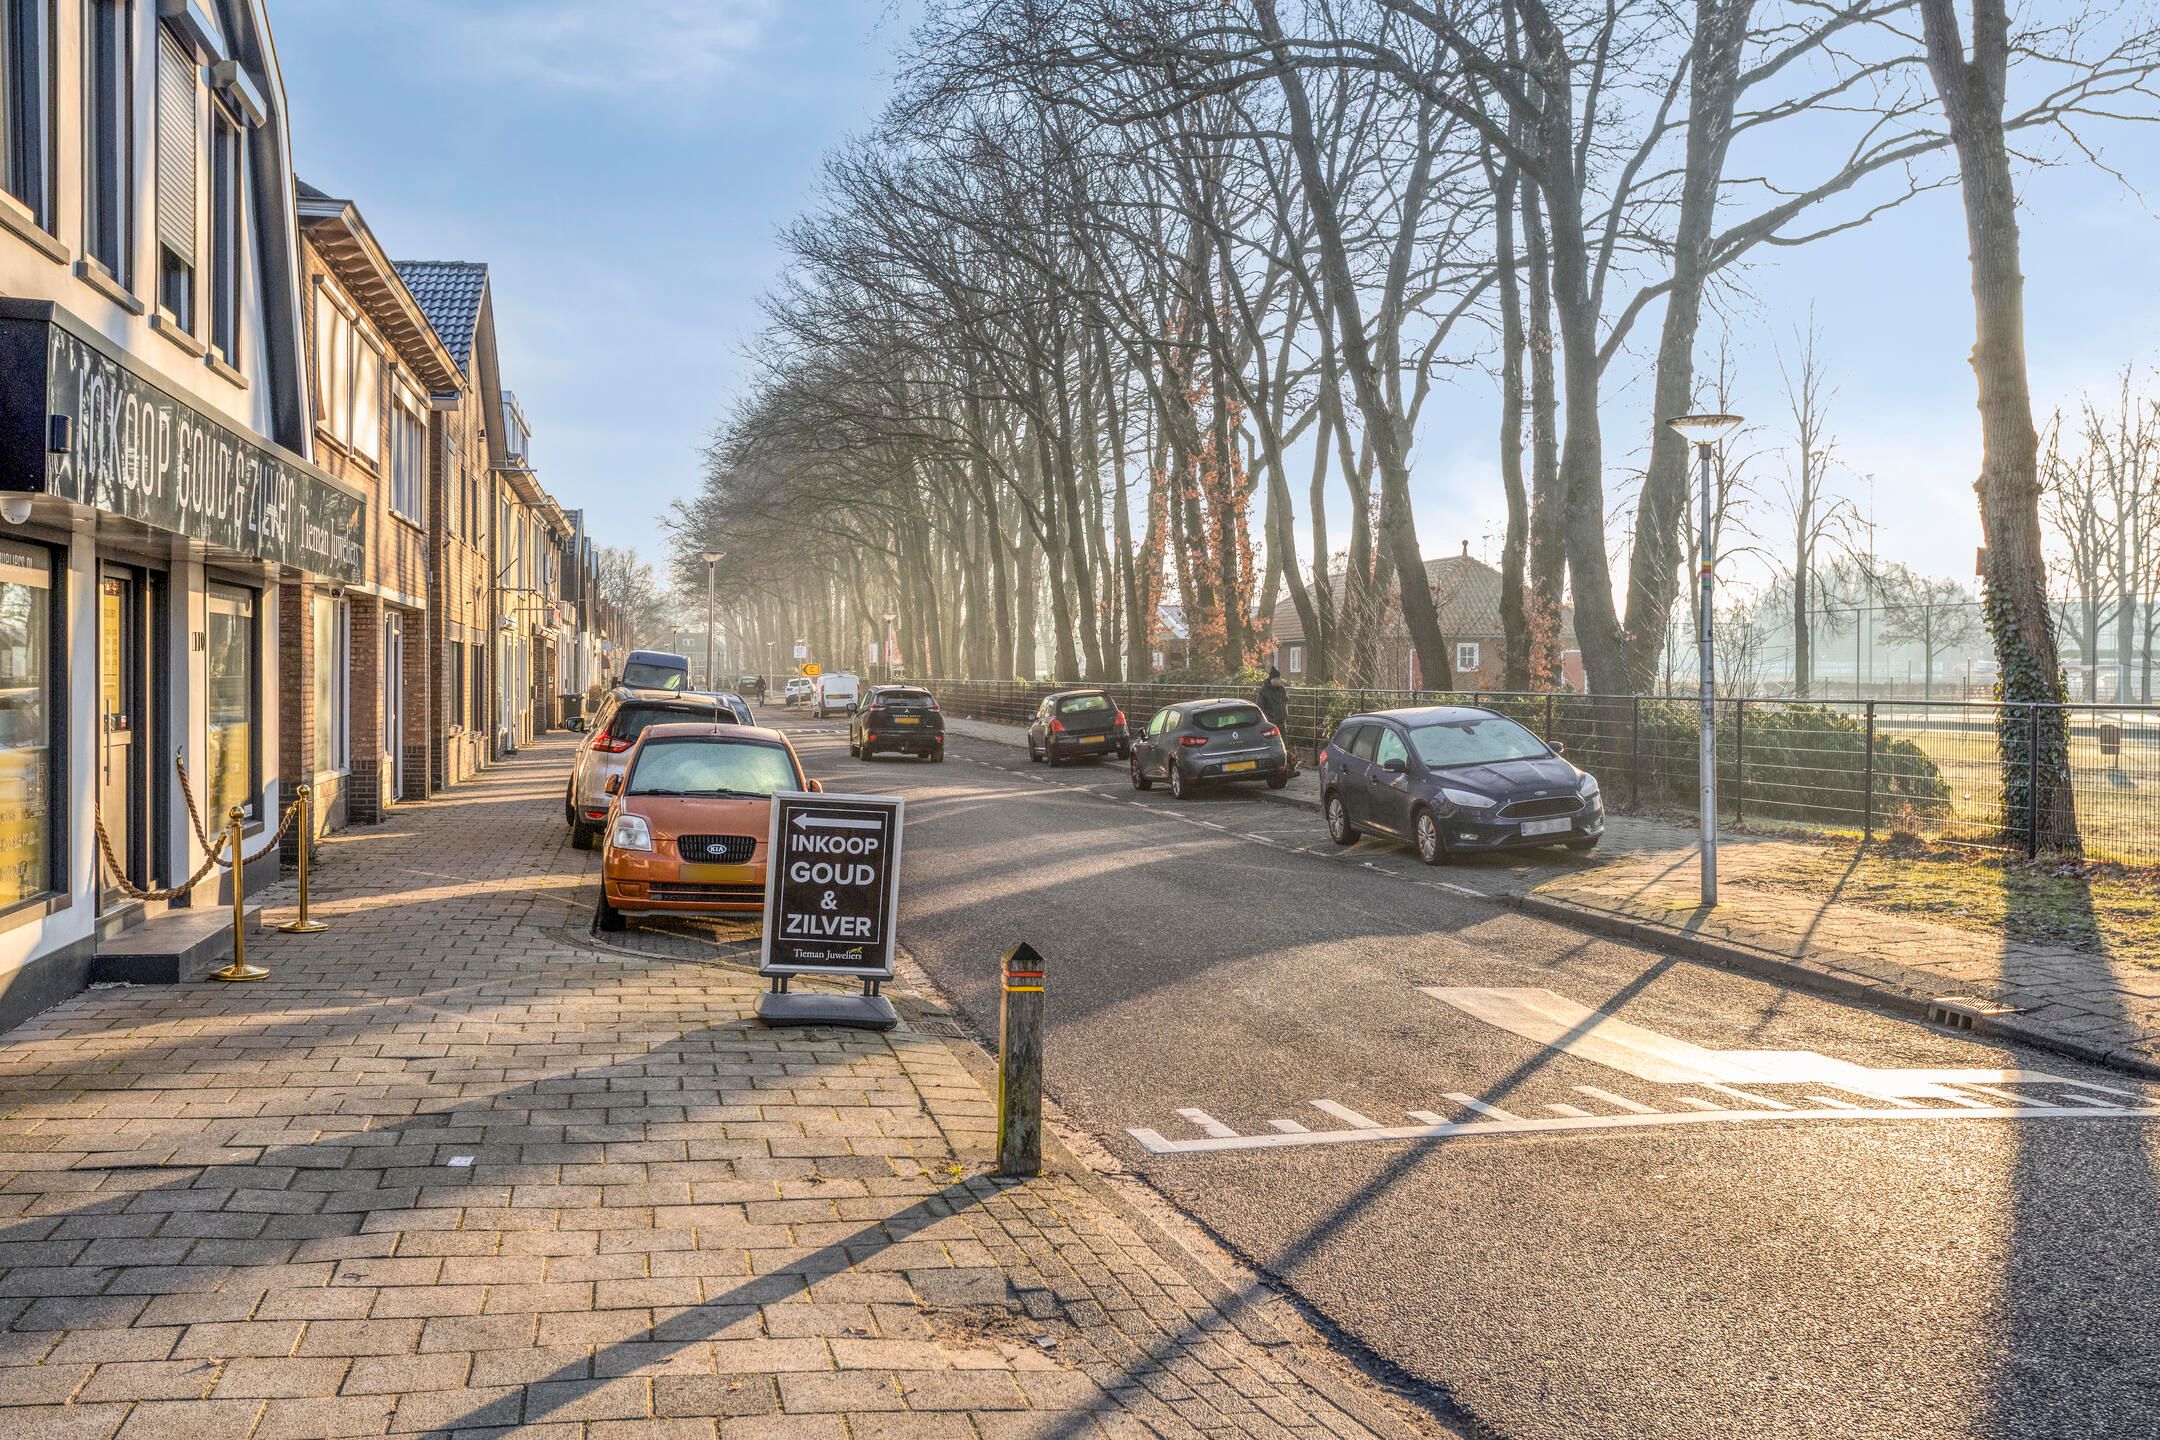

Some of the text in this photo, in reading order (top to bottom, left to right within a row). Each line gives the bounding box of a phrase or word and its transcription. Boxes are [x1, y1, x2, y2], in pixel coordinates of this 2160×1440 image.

[178, 420, 229, 520] GOUD
[234, 450, 245, 528] &
[299, 502, 329, 556] Tieman
[791, 834, 879, 855] INKOOP
[790, 862, 875, 886] GOUD
[820, 890, 838, 911] &
[786, 913, 872, 937] ZILVER
[793, 948, 862, 961] Tieman Juweliers
